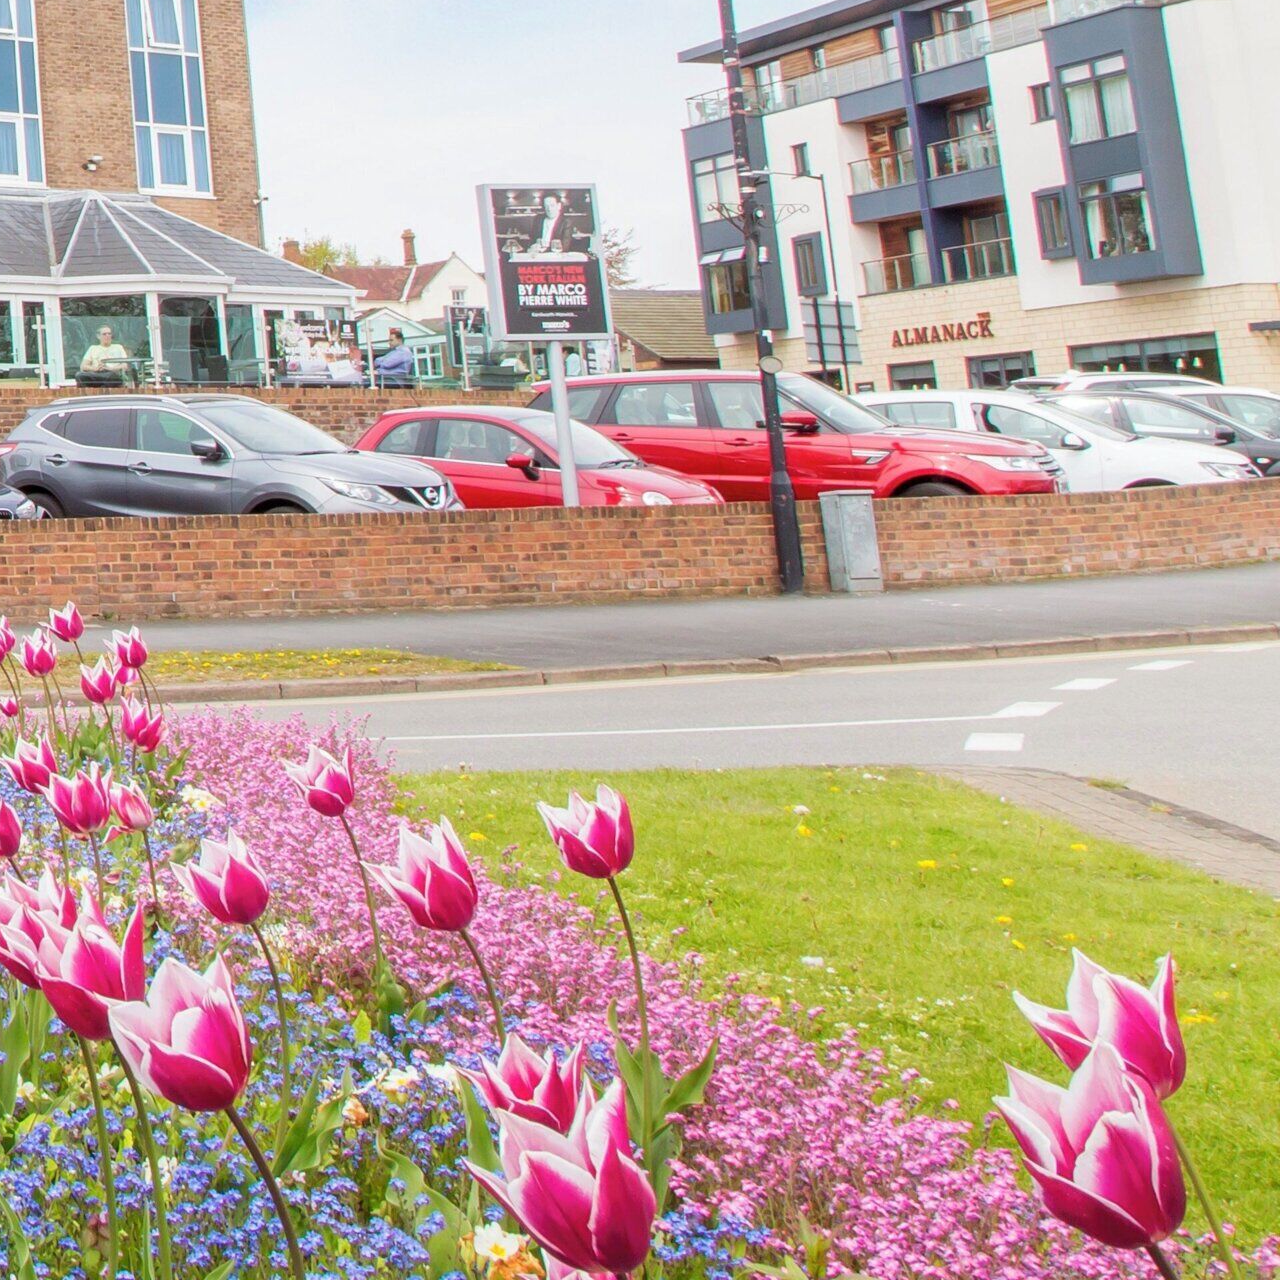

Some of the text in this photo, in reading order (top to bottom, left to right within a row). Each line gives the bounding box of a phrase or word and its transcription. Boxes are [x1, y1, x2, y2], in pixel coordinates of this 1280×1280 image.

[518, 284, 586, 295] BY MARCO
[519, 295, 588, 305] PIERRE WHITE
[892, 321, 994, 348] ALMANACK
